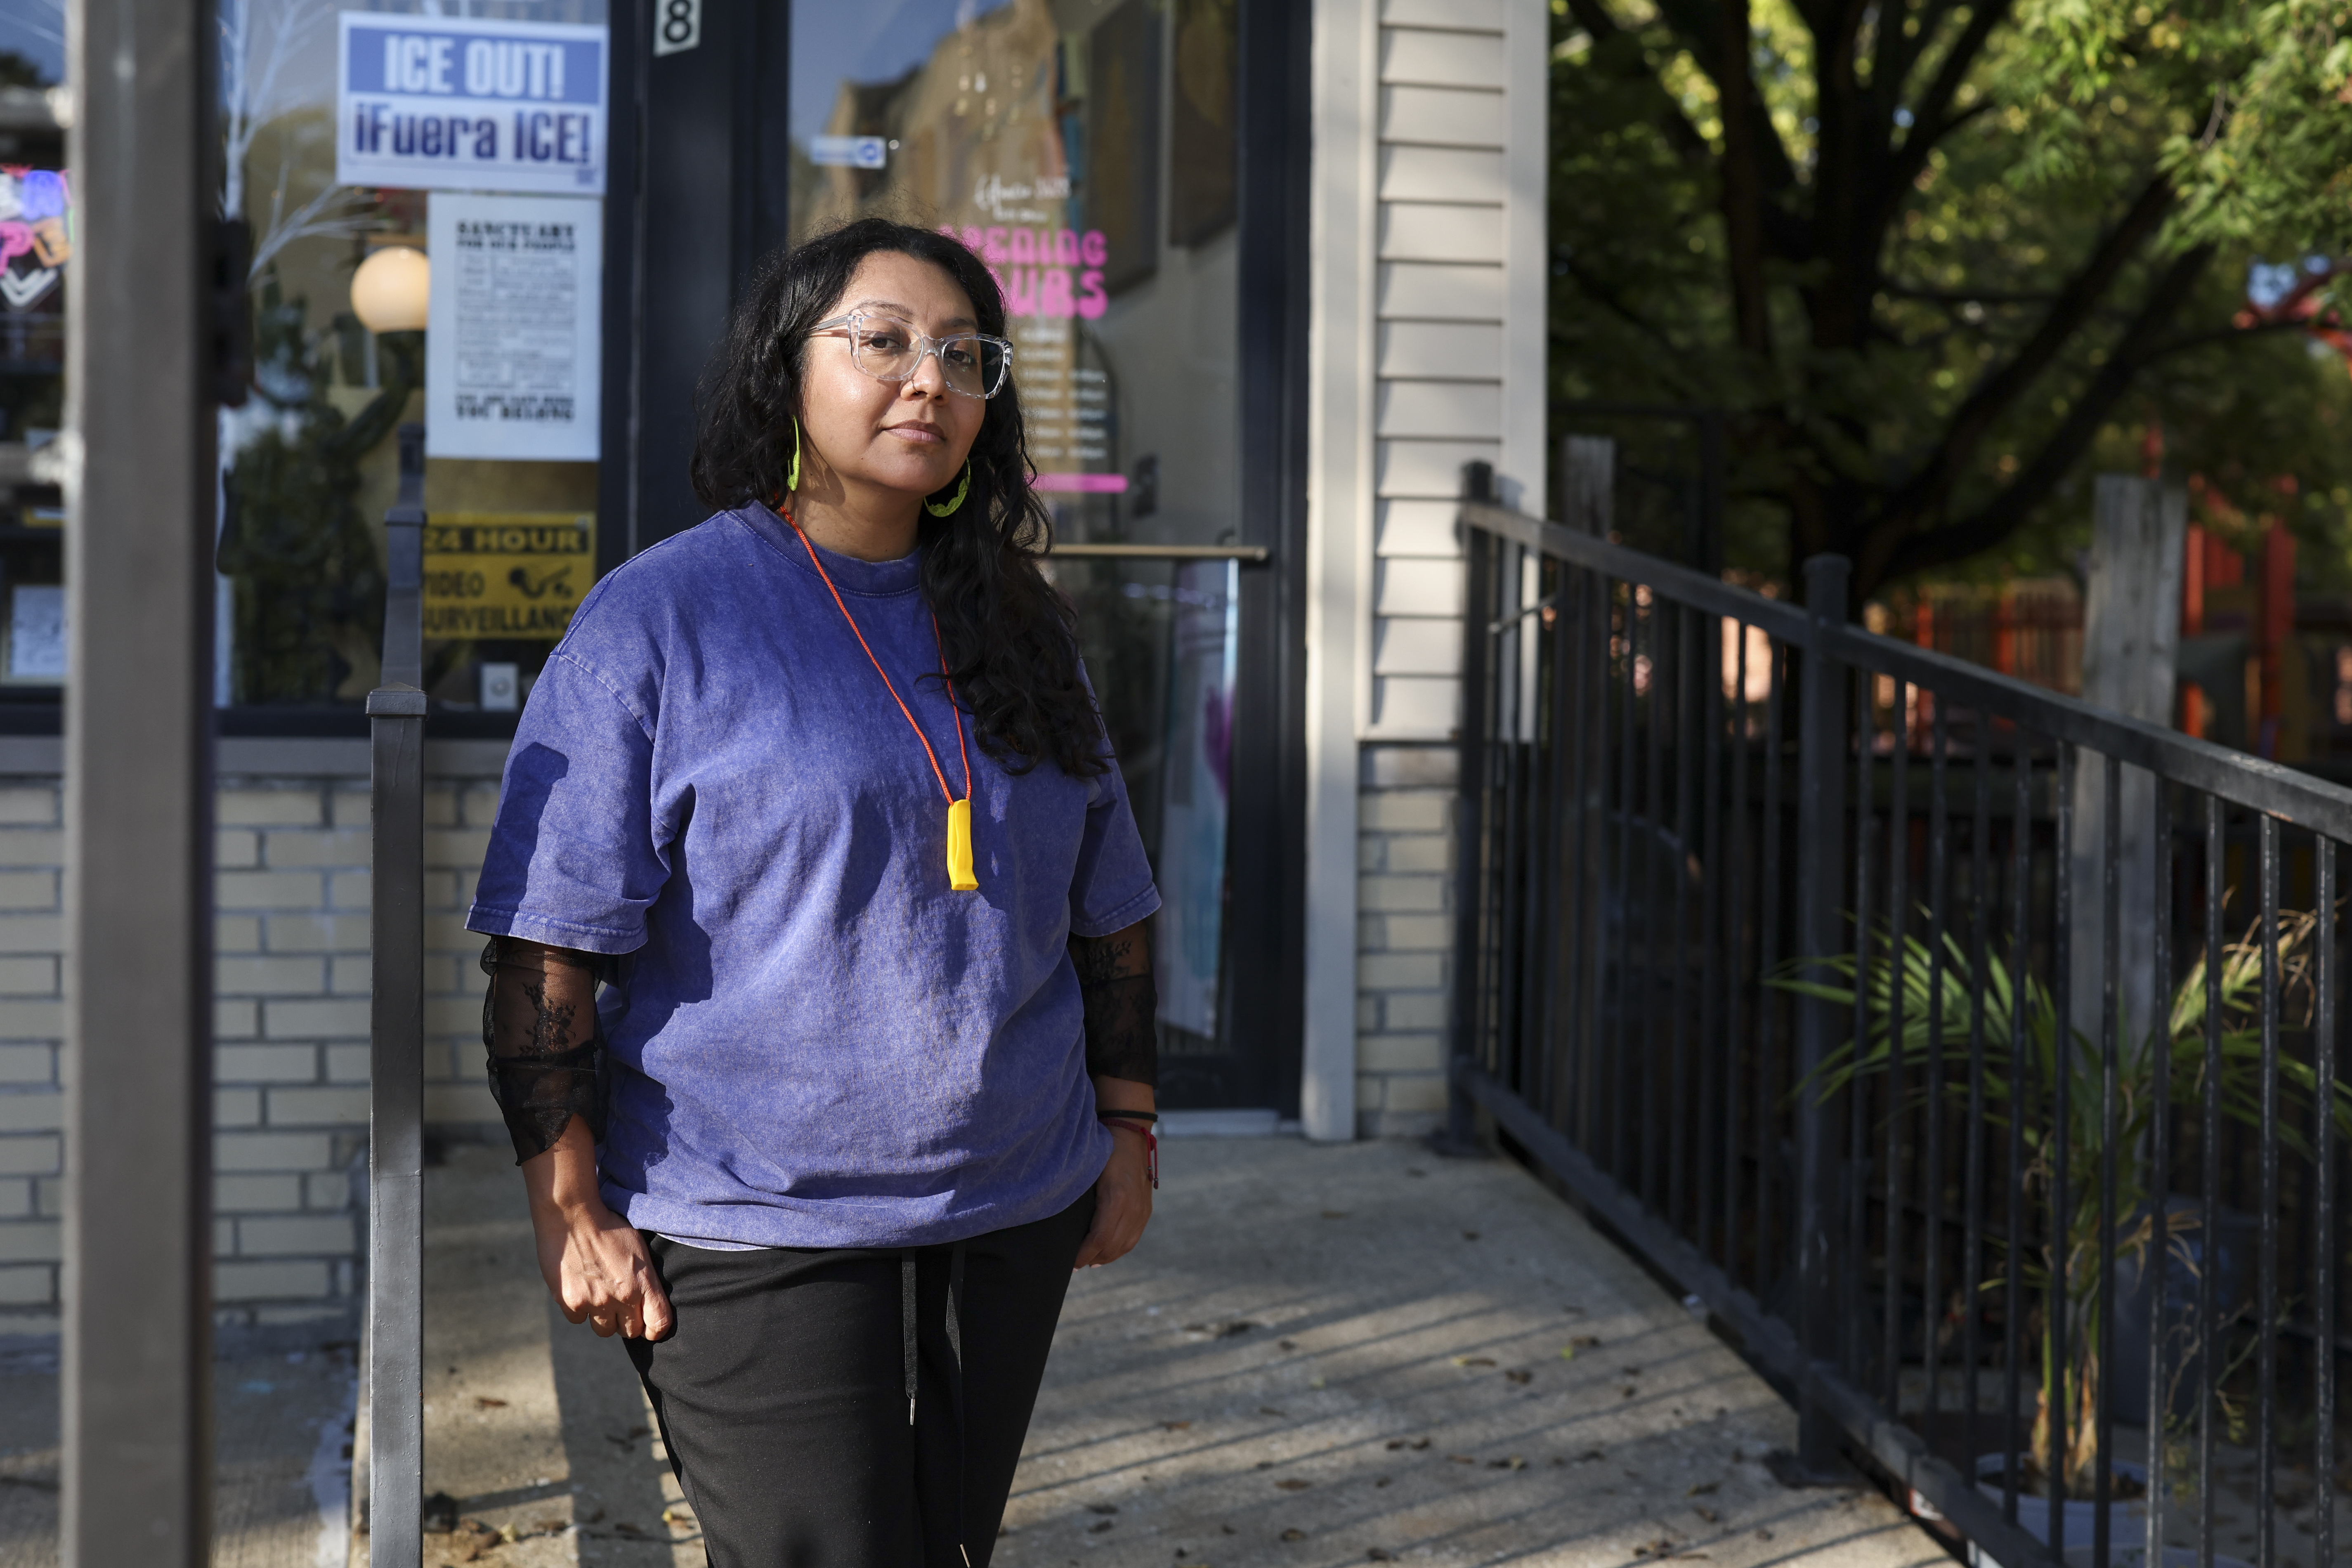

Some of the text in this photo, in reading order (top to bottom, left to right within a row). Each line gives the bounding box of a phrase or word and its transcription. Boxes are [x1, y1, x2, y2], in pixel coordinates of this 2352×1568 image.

[664, 0, 692, 43] 8
[384, 34, 564, 100] ICE OUT!
[354, 102, 592, 165] ¡Fuera ICE!
[474, 528, 581, 552] HOUR
